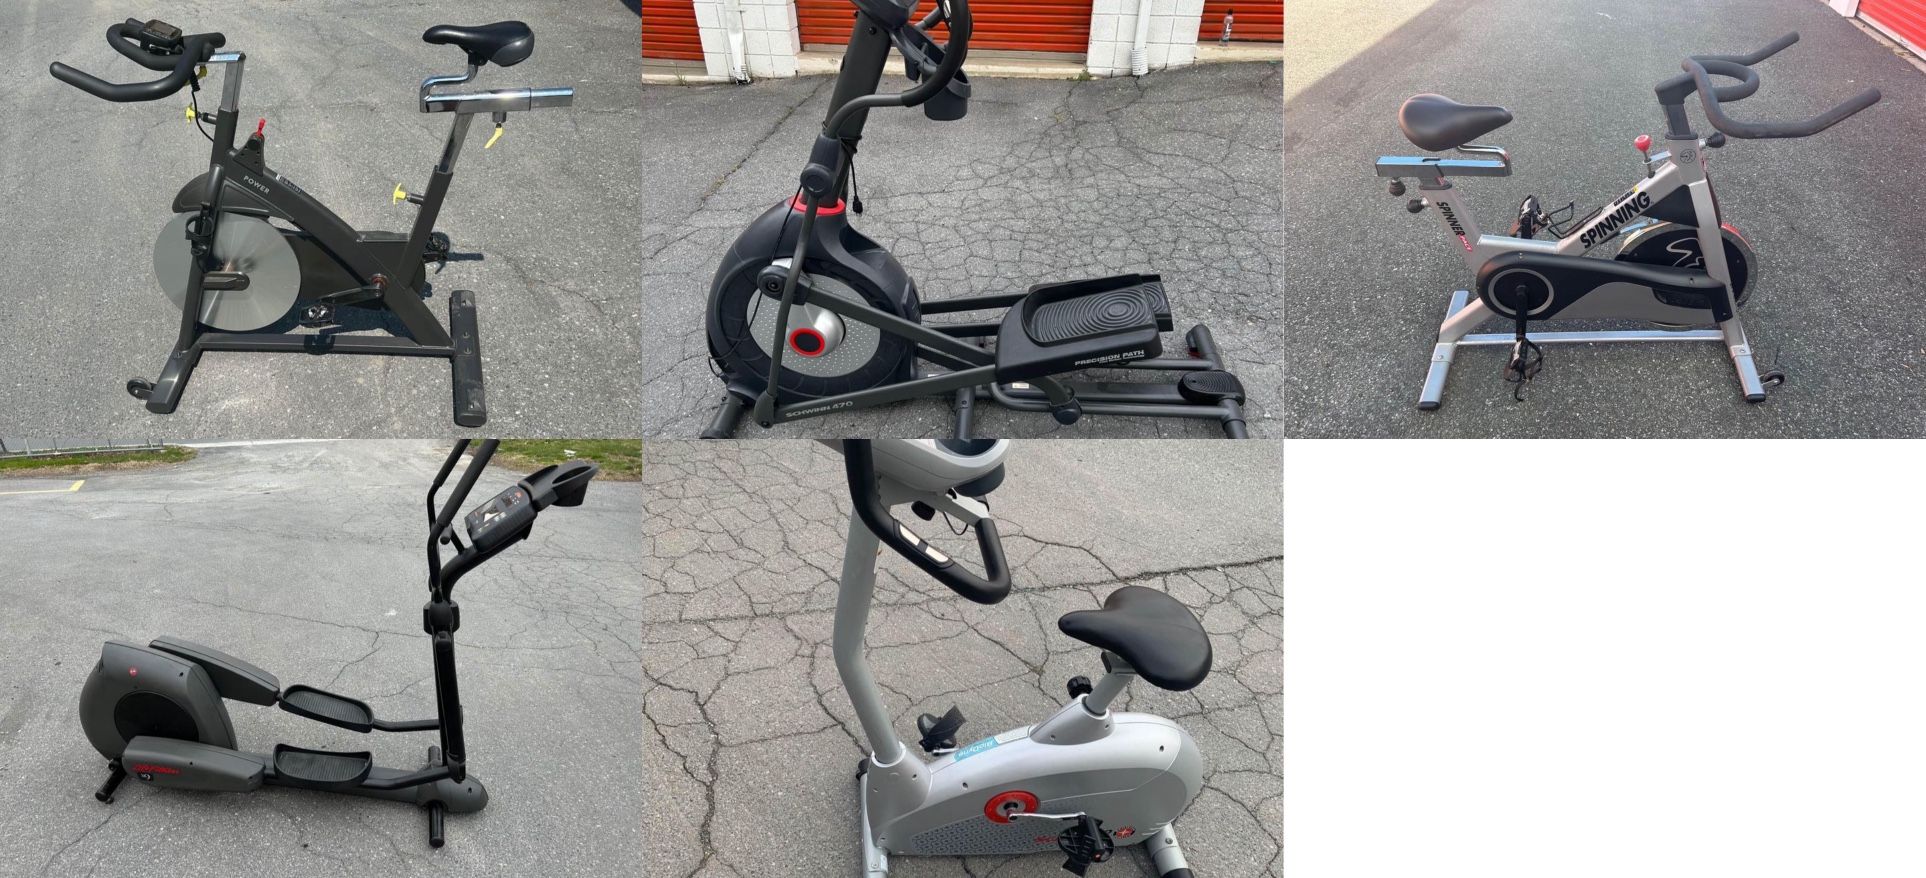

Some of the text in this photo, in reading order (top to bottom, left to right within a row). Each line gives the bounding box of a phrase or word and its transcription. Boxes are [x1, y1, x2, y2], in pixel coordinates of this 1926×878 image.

[243, 175, 270, 194] POWER
[1436, 201, 1466, 236] SPINNER
[1580, 191, 1651, 249] SPINNING
[1074, 353, 1121, 366] PRECISION
[1122, 349, 1145, 359] PATH
[785, 401, 853, 418] SCHWINN 470
